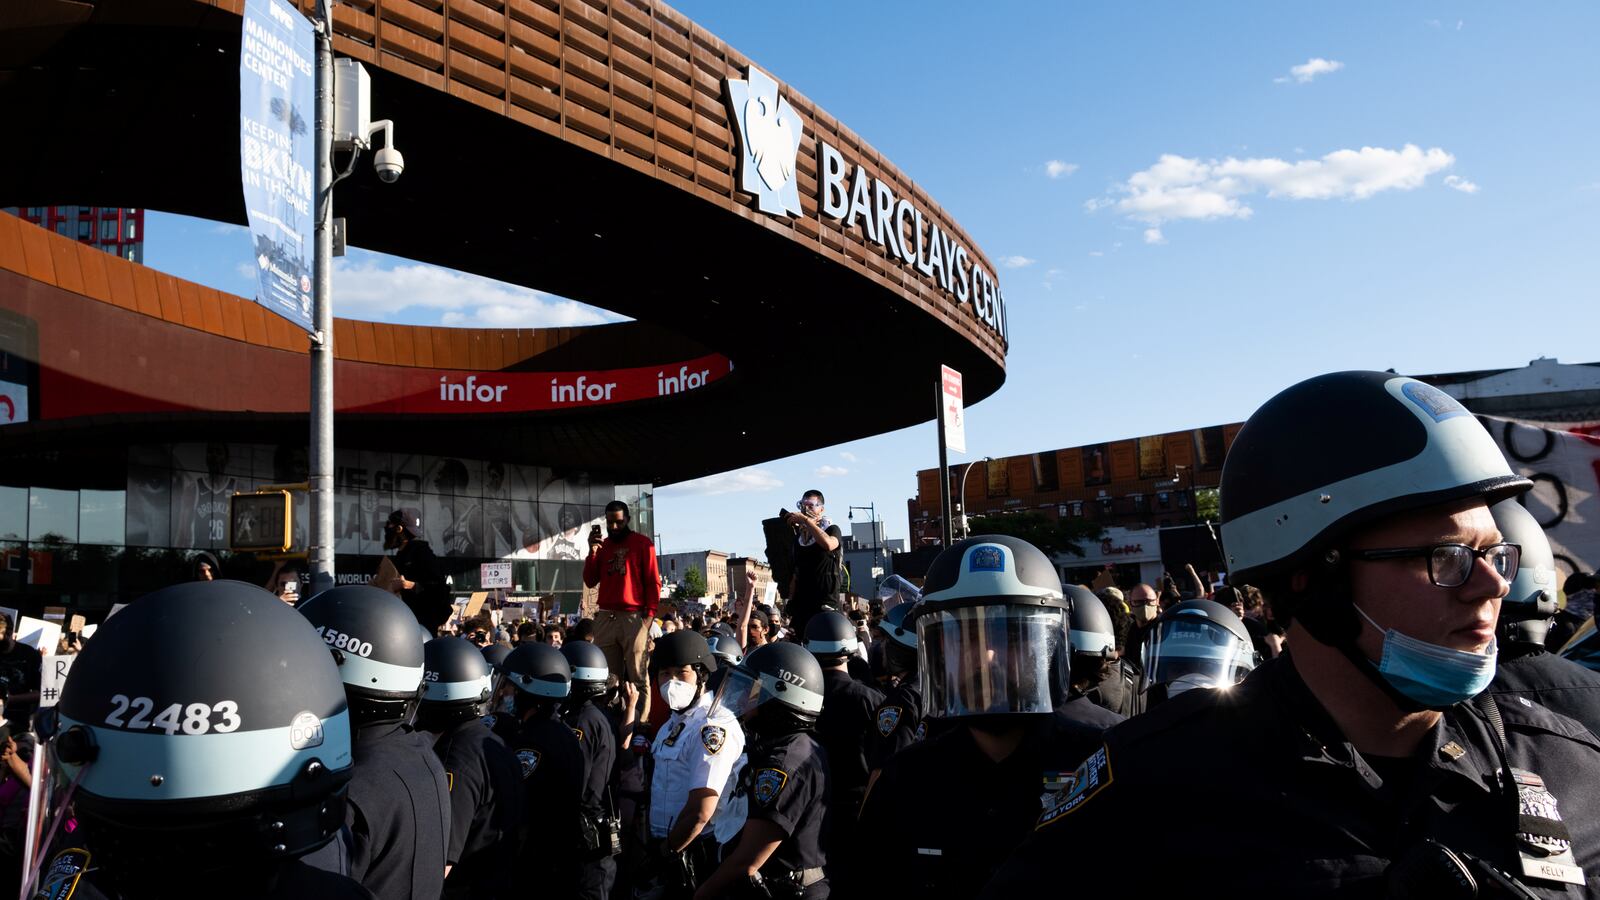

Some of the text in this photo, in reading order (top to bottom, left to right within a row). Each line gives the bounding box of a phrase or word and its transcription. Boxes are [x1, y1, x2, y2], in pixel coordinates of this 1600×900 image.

[245, 35, 295, 78] MEDICAL
[246, 17, 312, 77] MAIMONDES
[244, 53, 288, 91] CENTER
[243, 116, 292, 153] KEEPIN
[245, 169, 260, 189] IN
[285, 189, 309, 216] GAME
[819, 140, 1008, 344] BARCLAYS CEN
[440, 375, 508, 403] infor
[551, 375, 617, 402] infor
[658, 366, 710, 396] infor
[375, 470, 421, 501] GO
[208, 519, 224, 541] 26
[779, 669, 806, 687] 1077
[105, 694, 241, 736] 22483
[293, 724, 321, 743] DOT
[1059, 792, 1086, 813] YORK
[1540, 865, 1565, 877] KELLY
